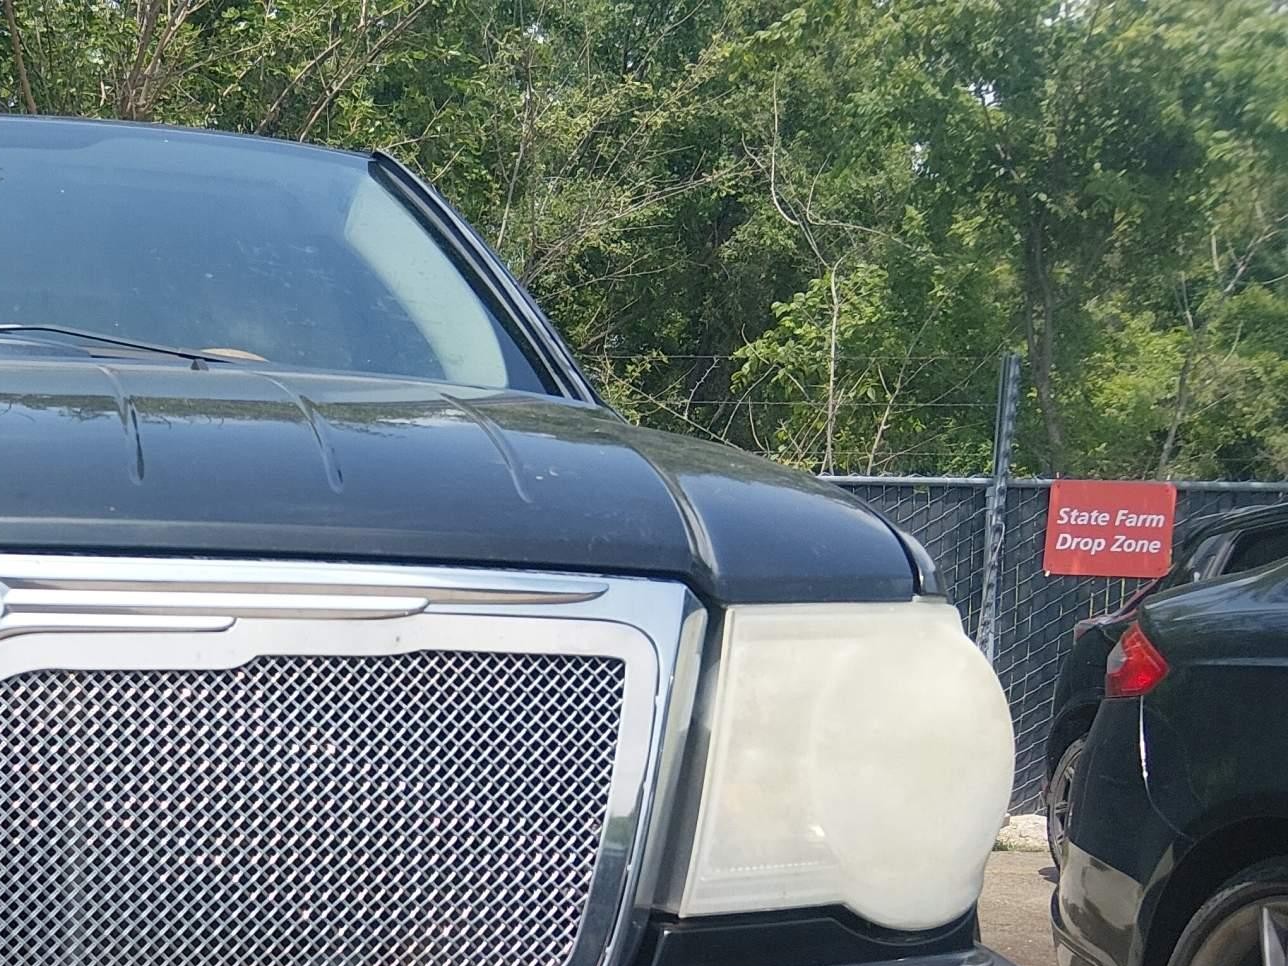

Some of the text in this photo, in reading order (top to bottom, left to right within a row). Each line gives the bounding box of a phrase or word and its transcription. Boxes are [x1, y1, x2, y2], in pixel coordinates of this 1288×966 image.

[1057, 508, 1165, 528] State Farm
[1056, 533, 1161, 555] Drop Zone
